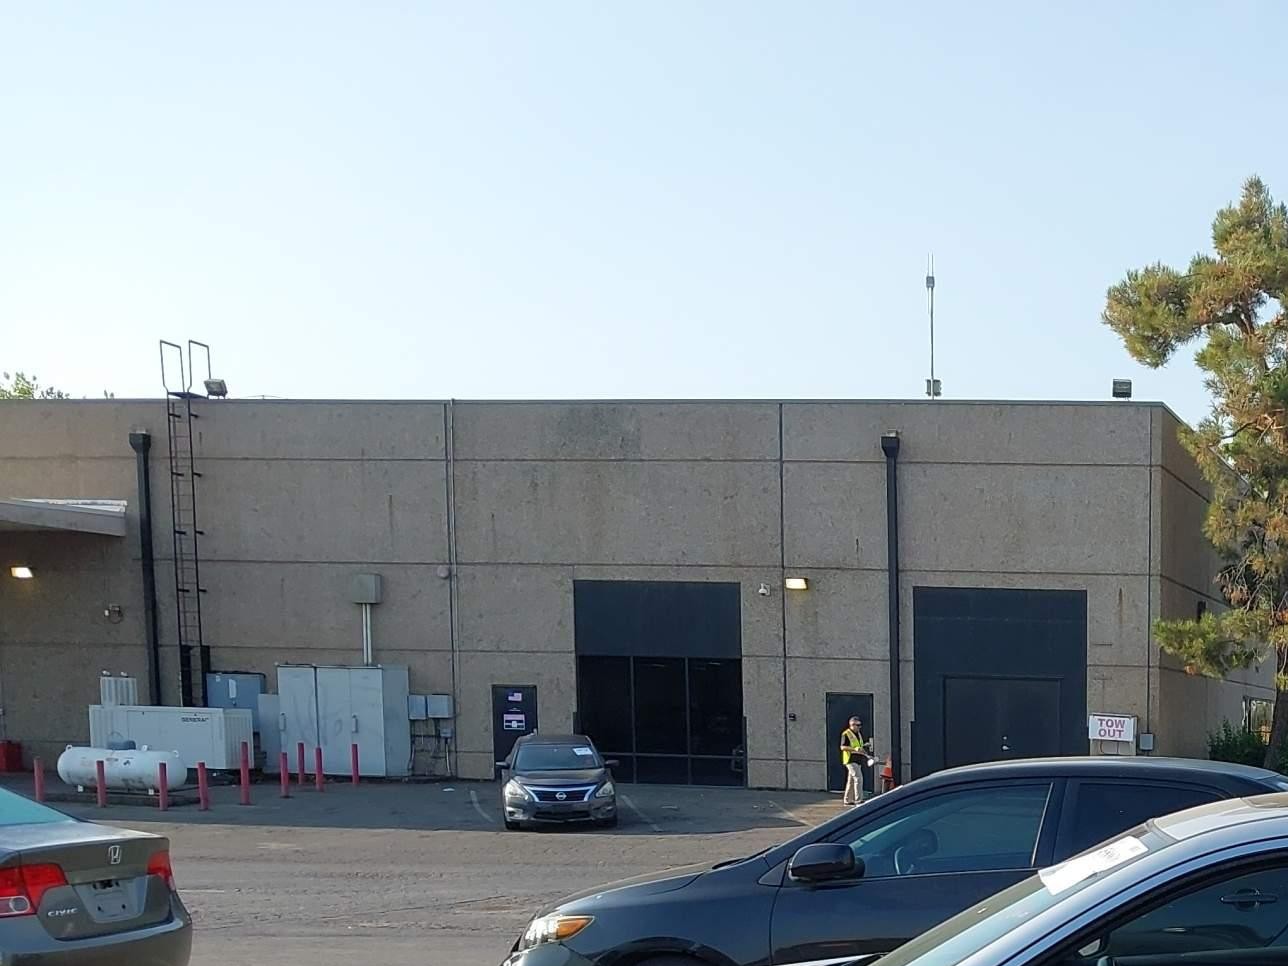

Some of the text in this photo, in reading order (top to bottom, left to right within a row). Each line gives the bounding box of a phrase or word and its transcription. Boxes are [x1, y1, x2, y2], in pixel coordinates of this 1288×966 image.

[1097, 718, 1126, 729] TOW
[1098, 728, 1125, 738] OUT
[47, 907, 79, 917] CIVIC
